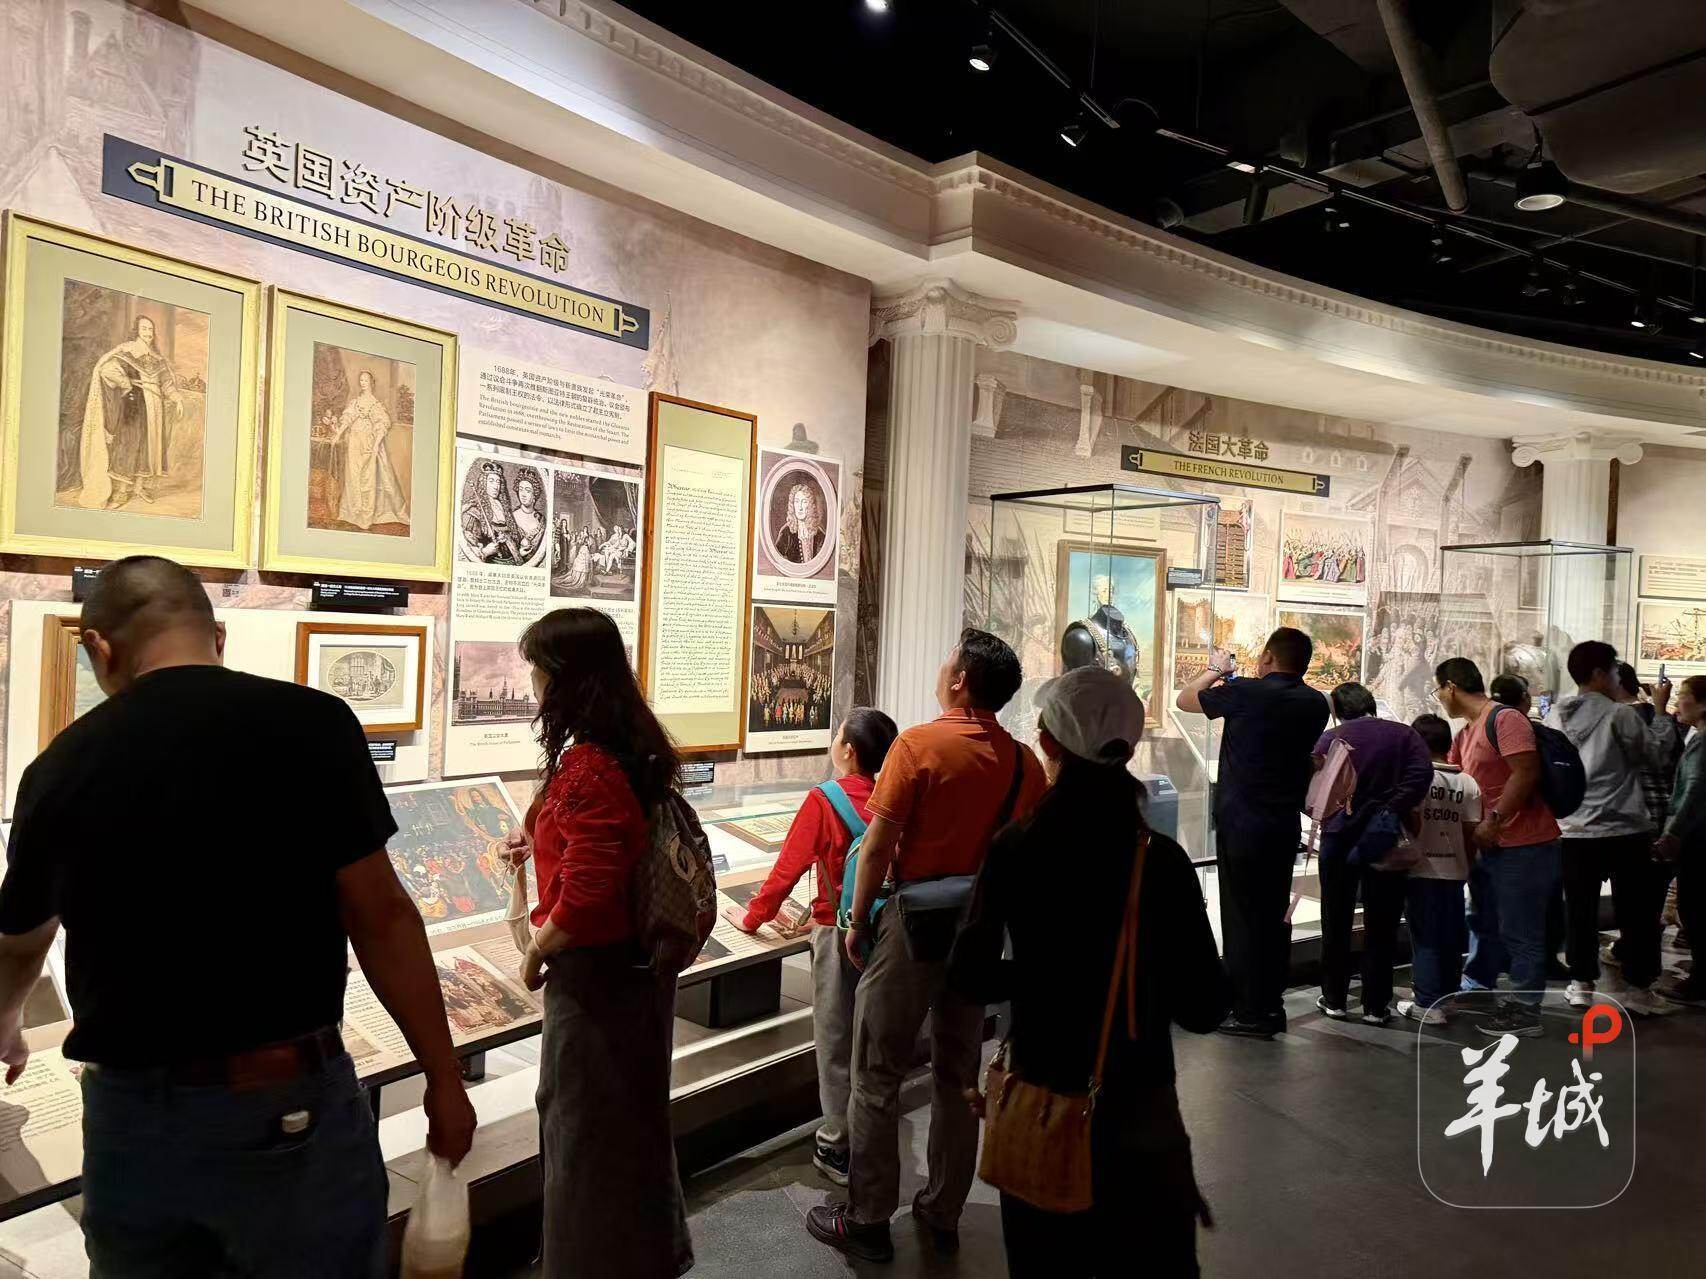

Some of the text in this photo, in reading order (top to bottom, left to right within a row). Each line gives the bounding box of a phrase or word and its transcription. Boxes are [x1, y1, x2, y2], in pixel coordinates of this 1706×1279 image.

[242, 125, 571, 273] 英国资产阶级革命
[192, 180, 604, 324] THE BRITISH BOURGEOIS REVOLUTION
[1188, 431, 1270, 463] 法国大革命
[1174, 460, 1284, 485] THE FRENCH REVOLUTION
[1431, 786, 1464, 804] GO TO
